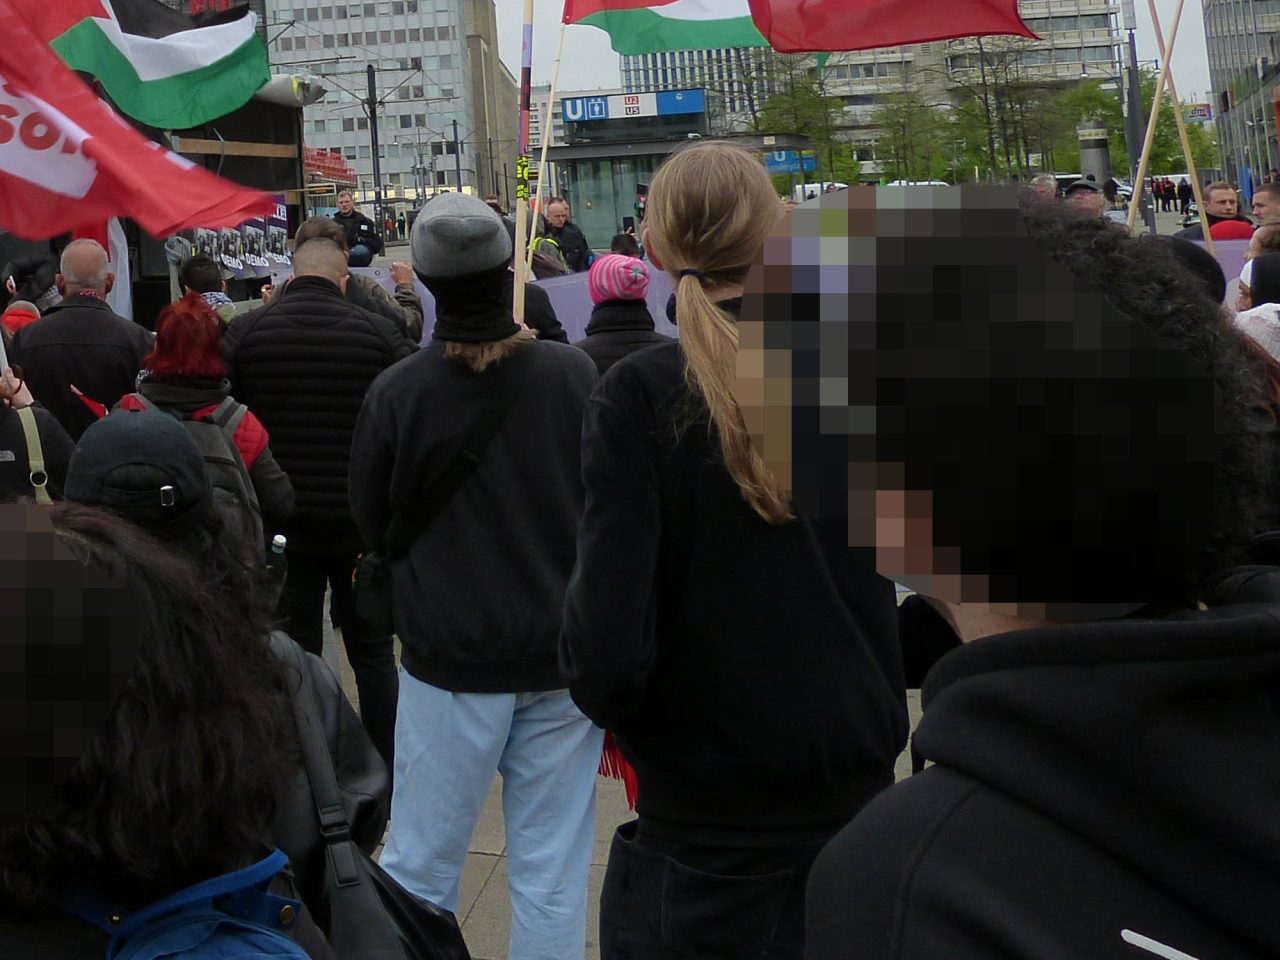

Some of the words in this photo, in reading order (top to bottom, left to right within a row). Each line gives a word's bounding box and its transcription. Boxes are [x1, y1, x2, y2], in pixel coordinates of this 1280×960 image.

[625, 96, 638, 105] U2
[565, 99, 583, 120] U
[626, 106, 639, 115] U5
[245, 252, 269, 267] DEMO
